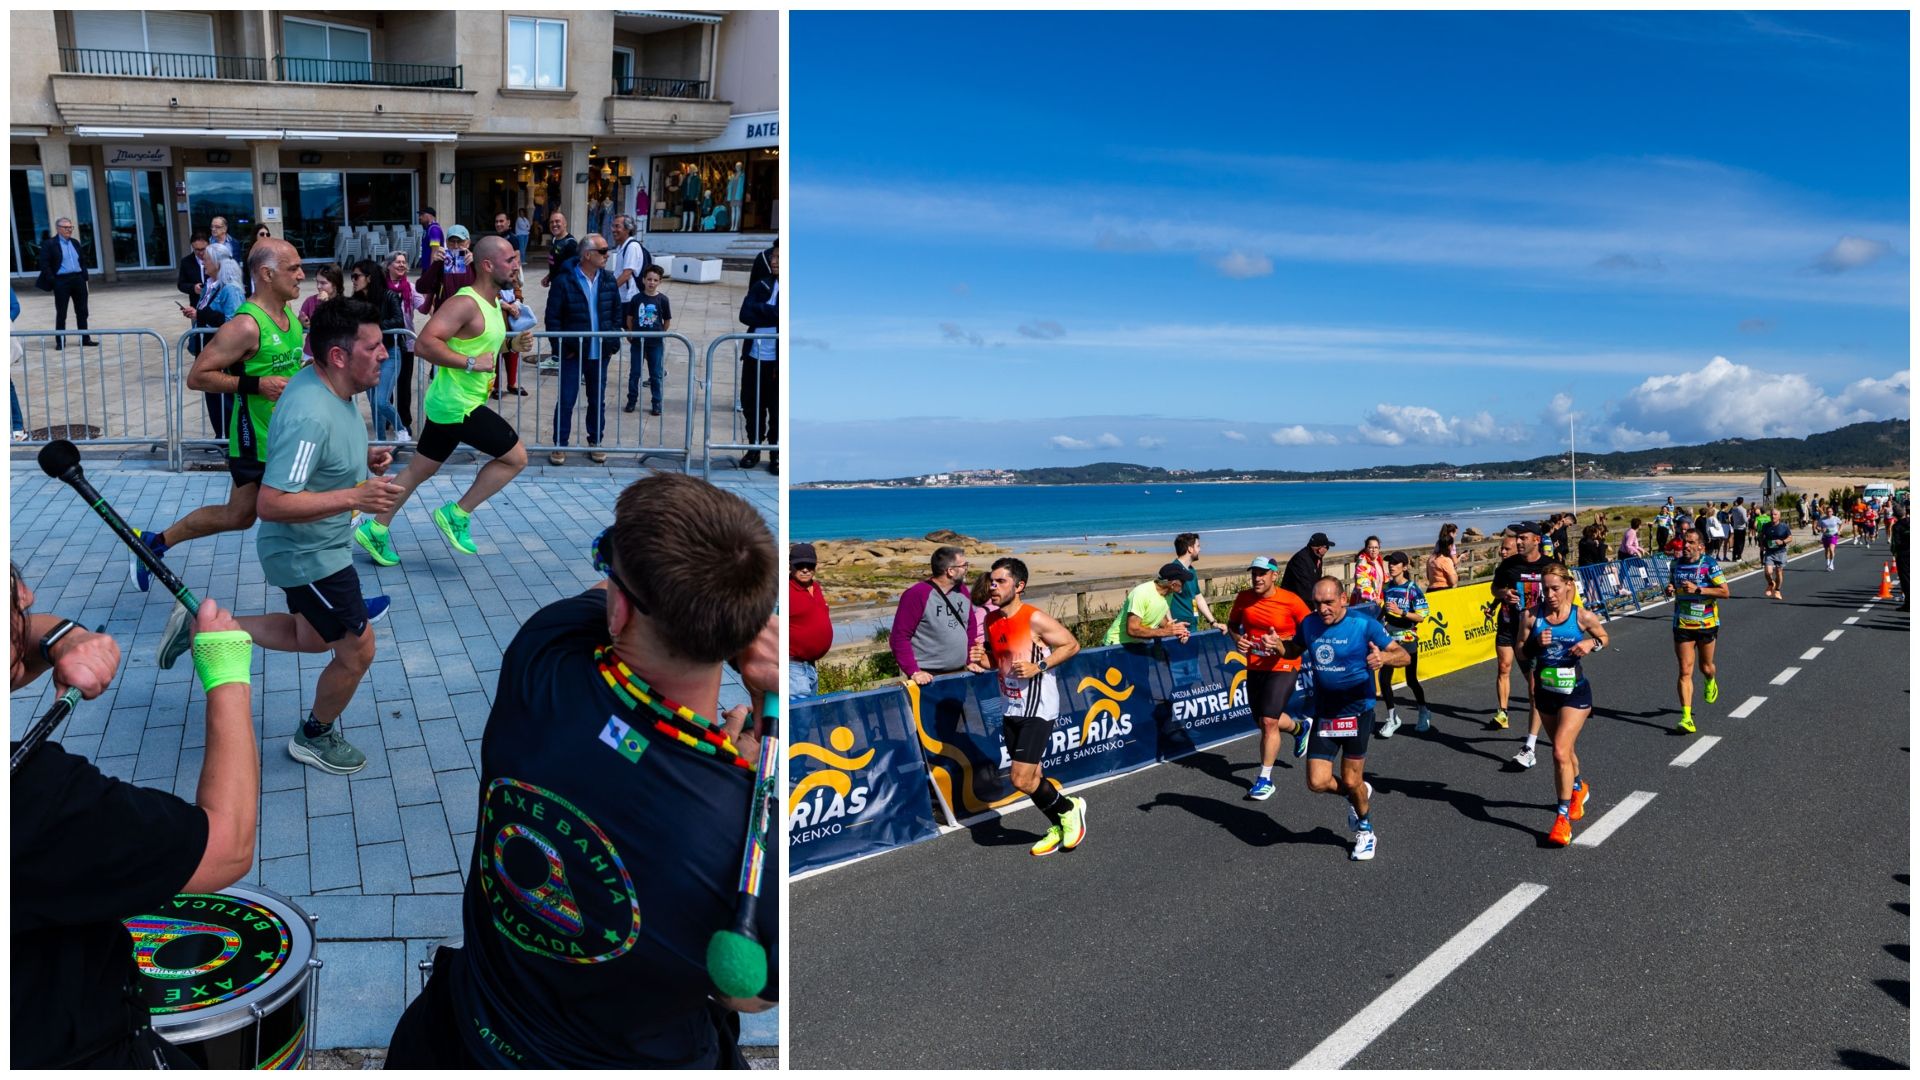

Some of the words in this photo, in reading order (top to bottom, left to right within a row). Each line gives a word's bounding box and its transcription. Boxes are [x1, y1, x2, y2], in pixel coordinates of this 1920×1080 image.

[1172, 689, 1191, 699] MEDIA
[1192, 682, 1223, 696] MARATÓN
[1172, 691, 1230, 721] ENTRE
[1087, 711, 1133, 745] RÍAS
[1194, 716, 1220, 727] GROVE
[1073, 739, 1125, 760] SANXENXO
[503, 789, 545, 821] AXÉ
[556, 819, 626, 905] BAHIA
[789, 823, 842, 847] XENXO
[160, 900, 272, 931] BATUCA
[164, 977, 234, 1004] AXÉ
